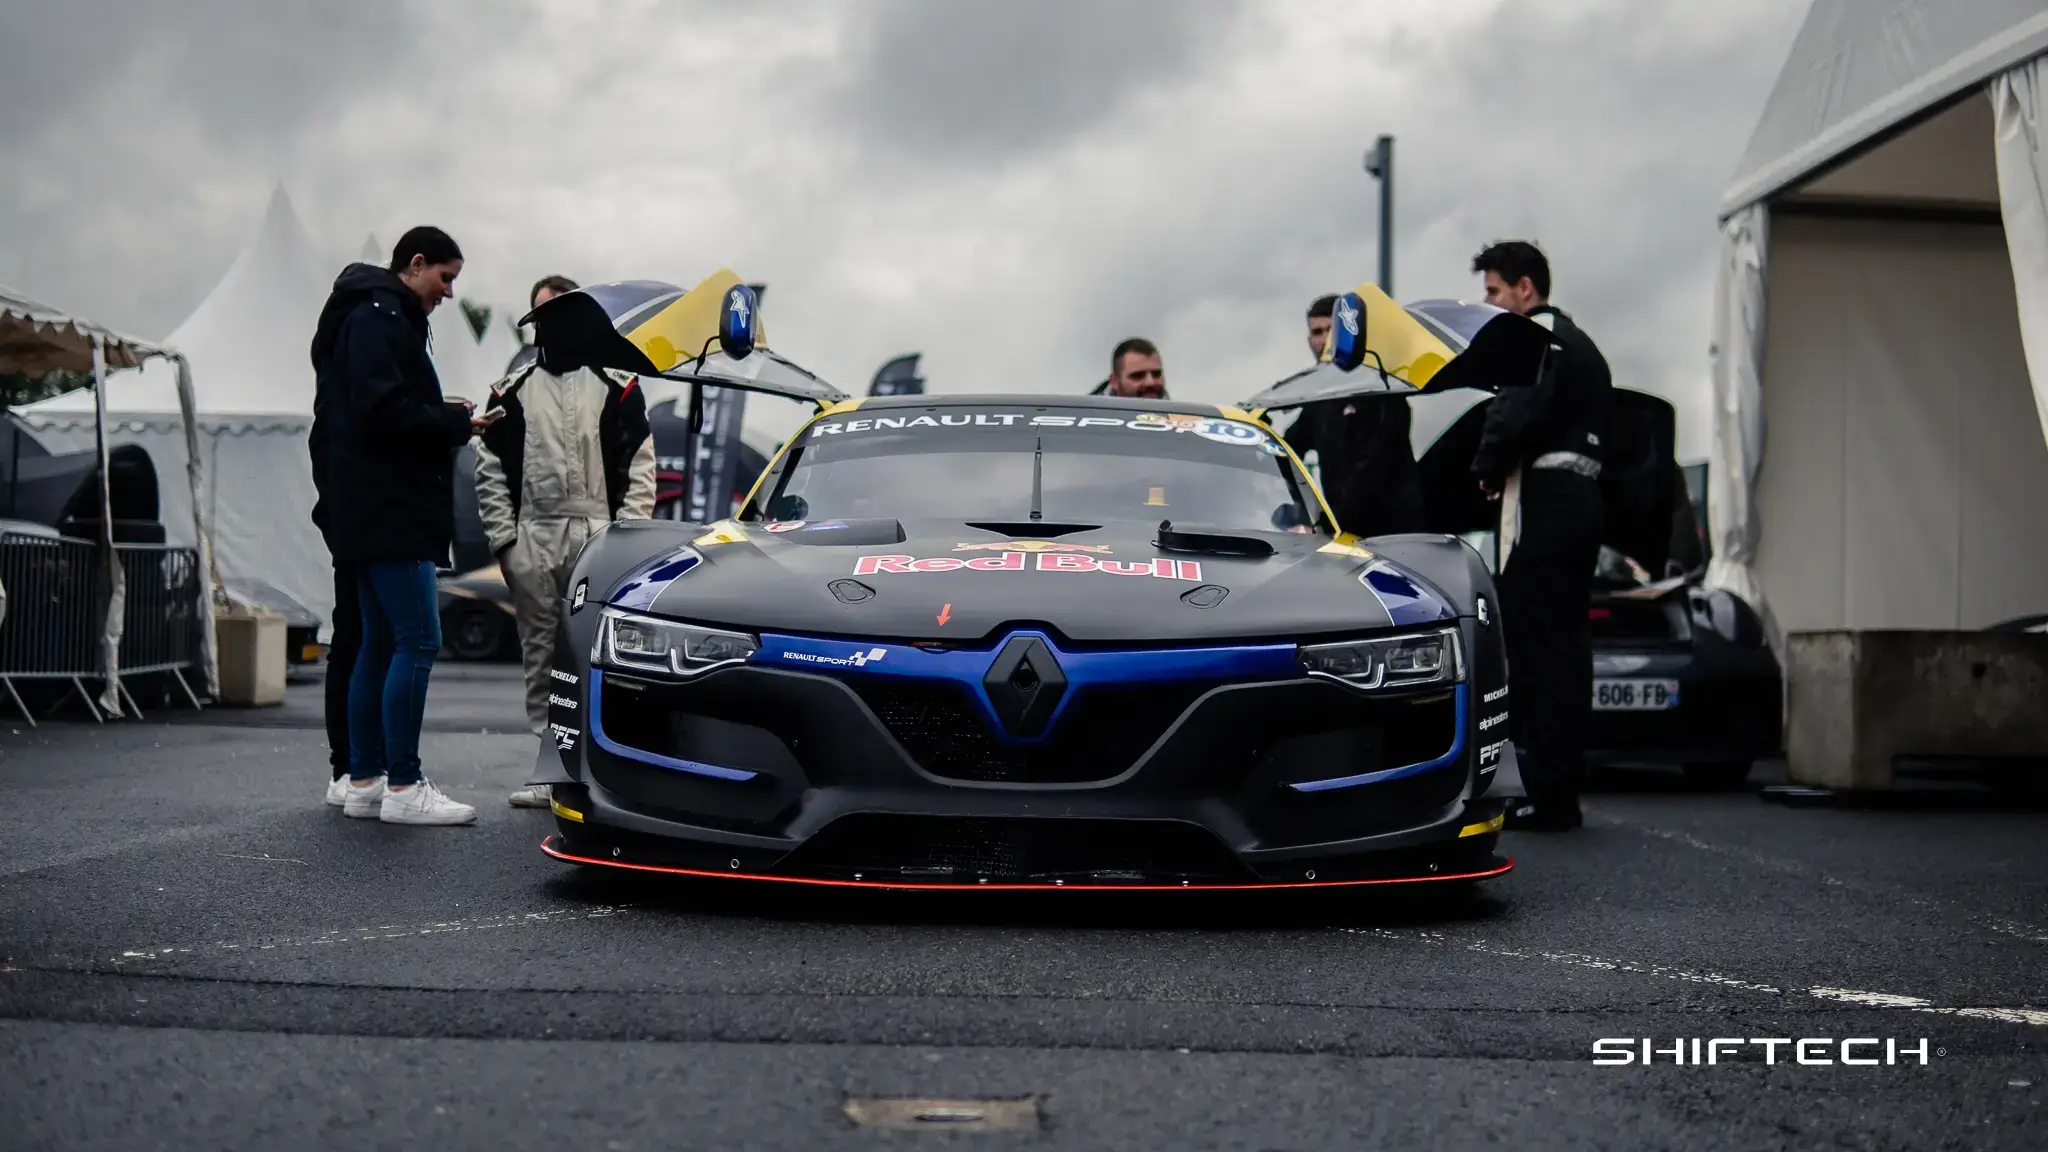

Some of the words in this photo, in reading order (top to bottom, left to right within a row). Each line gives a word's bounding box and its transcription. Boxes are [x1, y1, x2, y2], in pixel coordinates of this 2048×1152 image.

[812, 414, 1025, 438] RENAULT
[1028, 415, 1187, 434] SPO
[853, 552, 1027, 576] Red
[1036, 553, 1203, 582] Bull
[1480, 738, 1509, 765] PF
